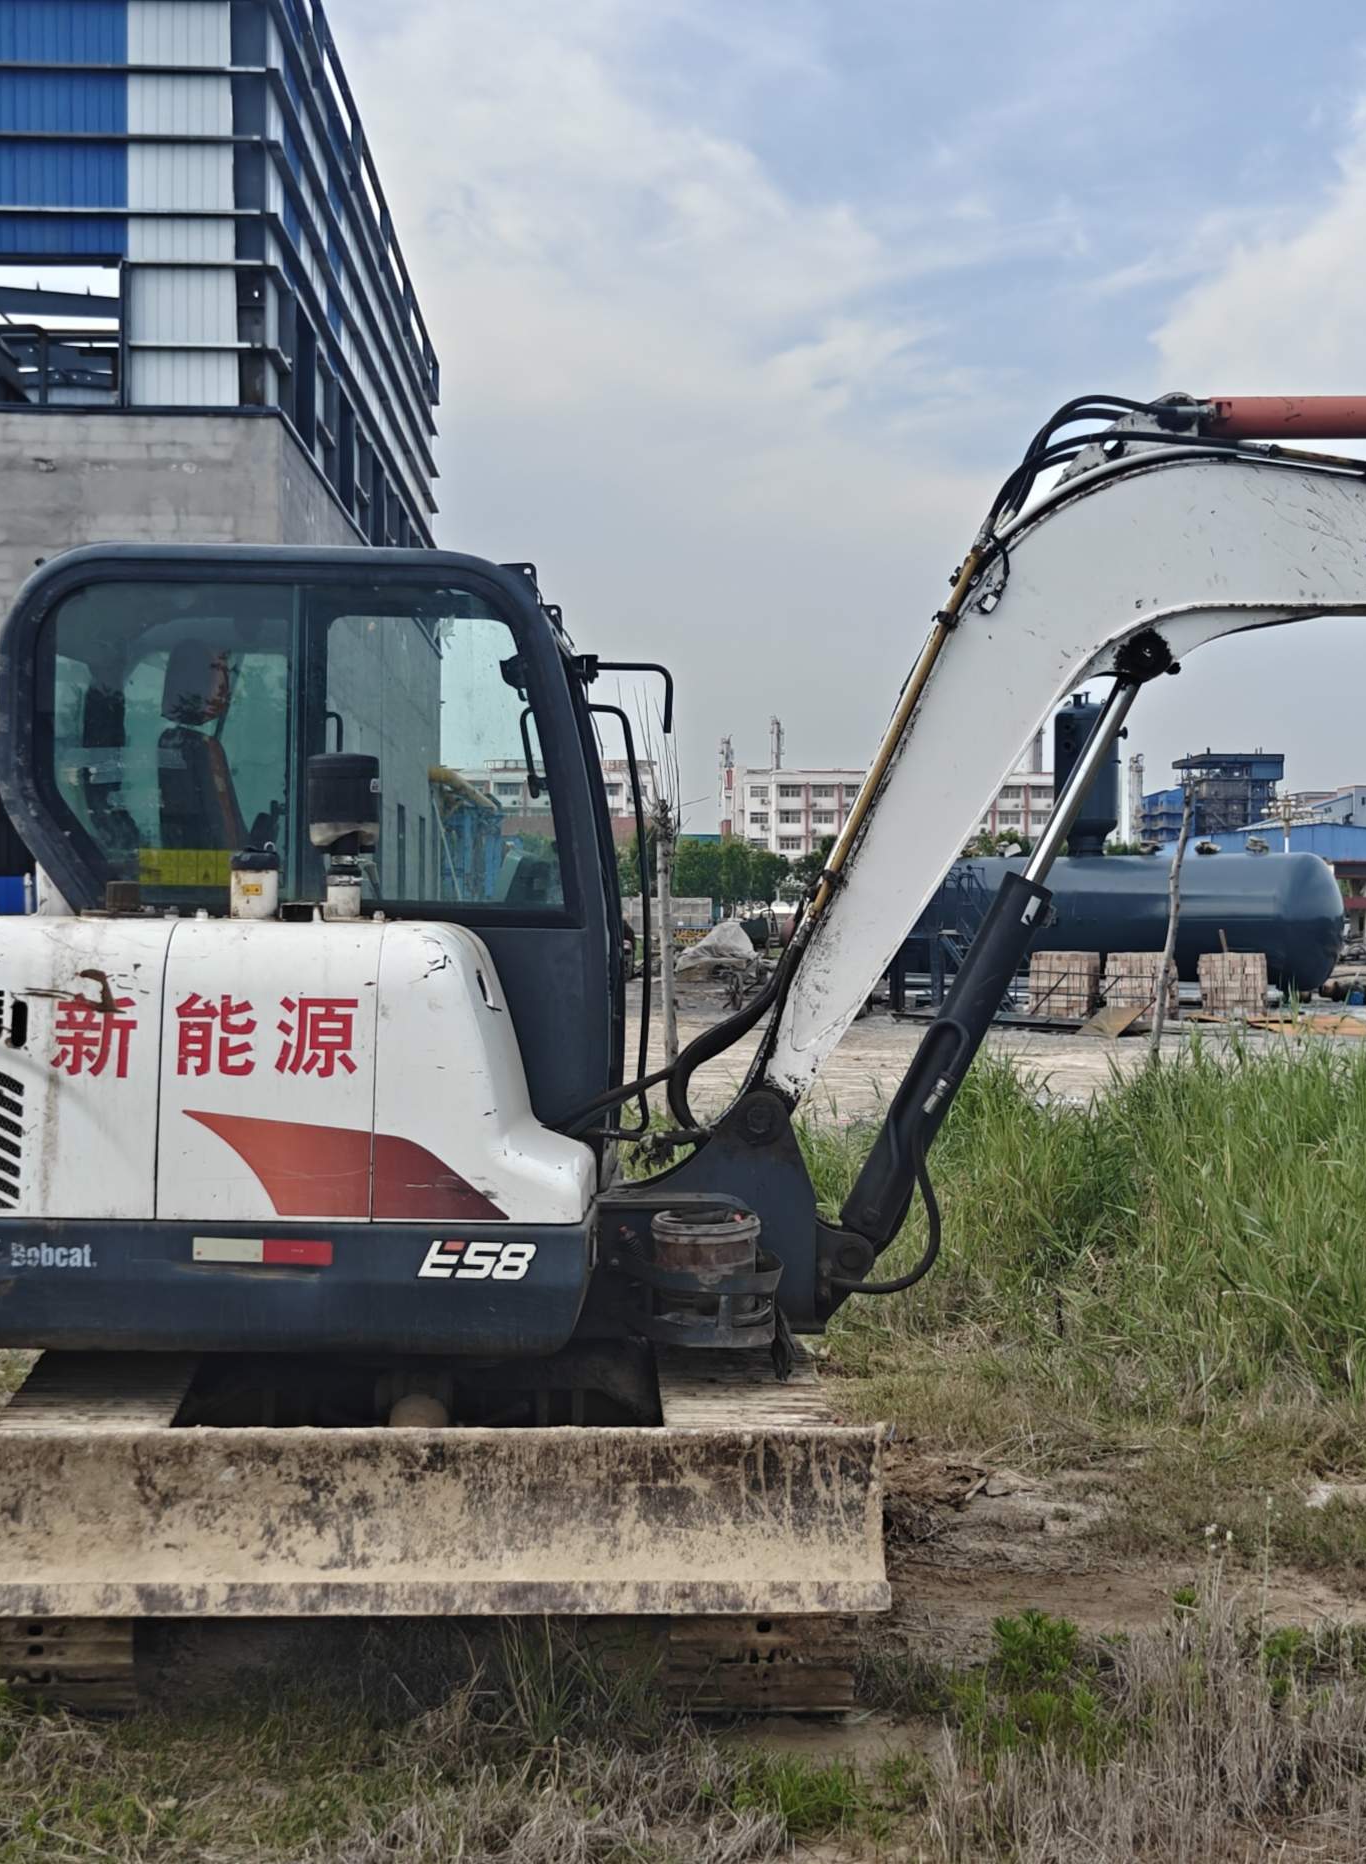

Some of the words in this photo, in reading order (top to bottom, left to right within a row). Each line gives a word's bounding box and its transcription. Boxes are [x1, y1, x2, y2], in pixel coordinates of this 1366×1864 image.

[50, 991, 359, 1079] 新能源
[417, 1240, 537, 1281] E58
